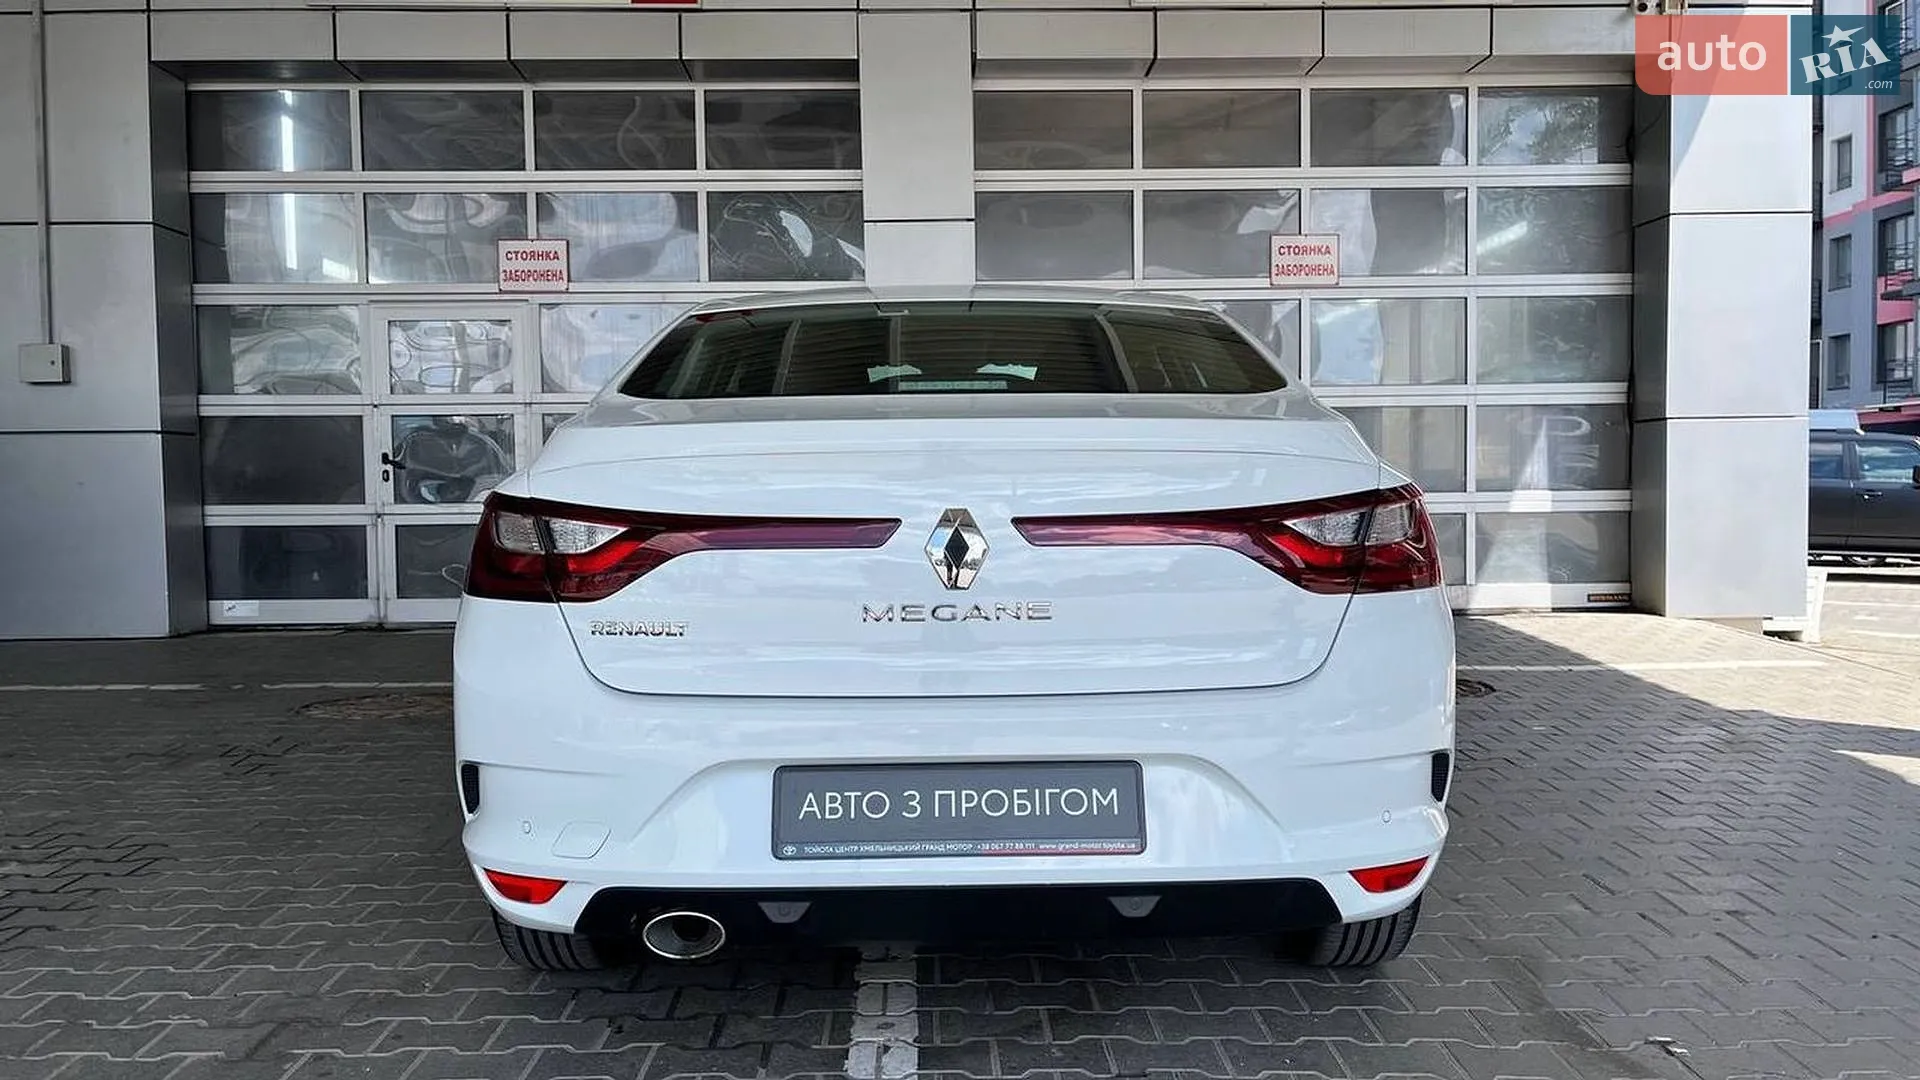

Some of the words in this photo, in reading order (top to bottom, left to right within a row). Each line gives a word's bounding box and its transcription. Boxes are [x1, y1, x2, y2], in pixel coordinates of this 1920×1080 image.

[505, 250, 560, 261] СТОЯНКА
[1278, 245, 1331, 256] СТОЯНКА
[502, 269, 564, 282] ЗАБОРОНЕНА
[1275, 263, 1335, 277] ЗАБОРОНЕНА
[862, 601, 1053, 623] MEGANE
[590, 620, 689, 637] RENAULT
[798, 790, 890, 820] АВТО
[934, 788, 1119, 818] ПРОБІГОМ
[946, 843, 973, 851] МОТОР
